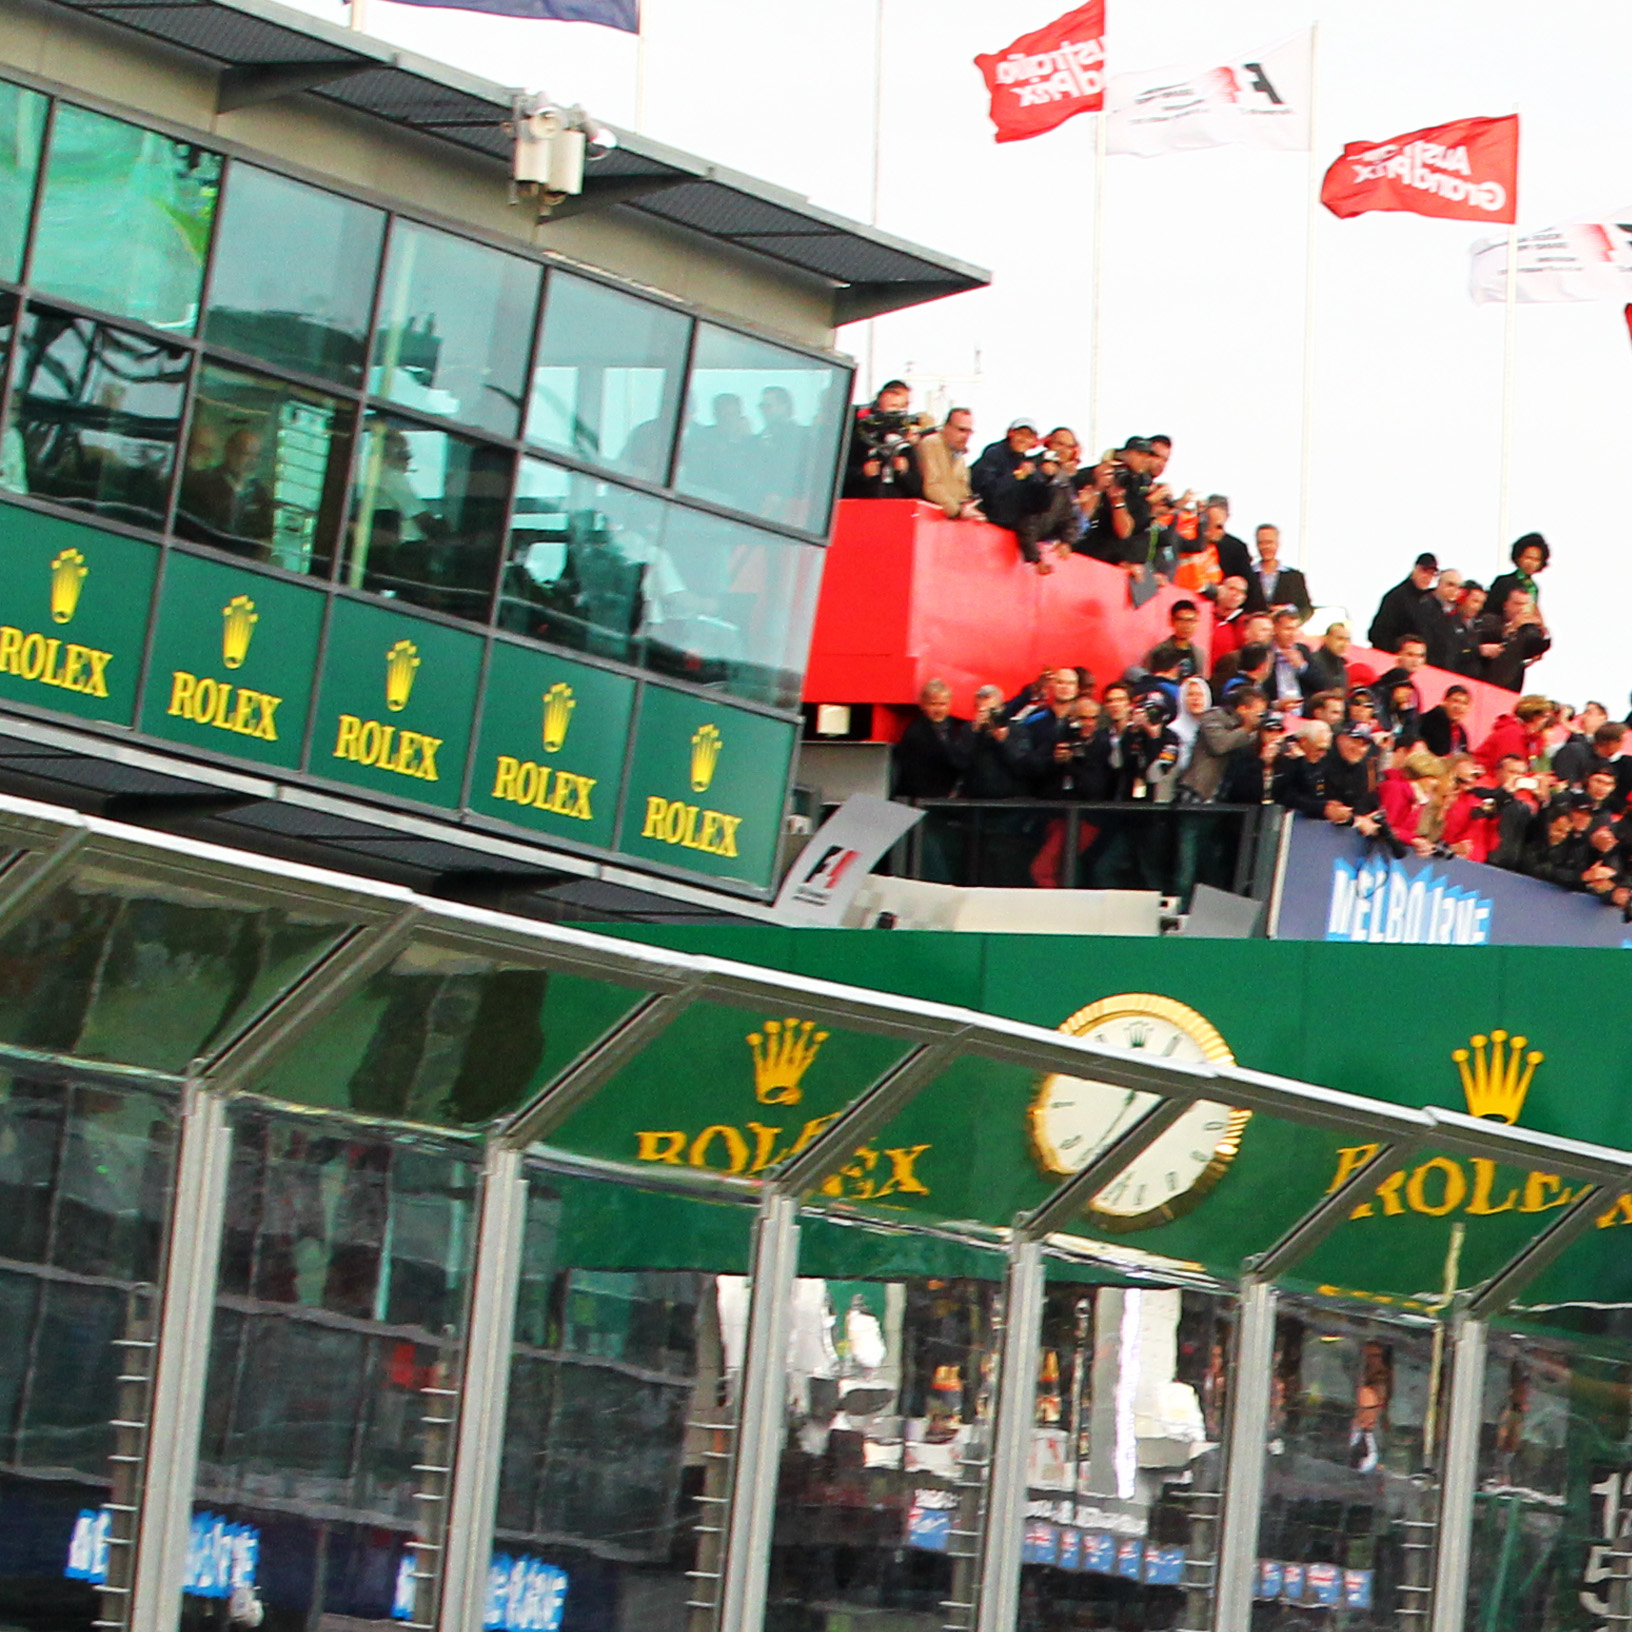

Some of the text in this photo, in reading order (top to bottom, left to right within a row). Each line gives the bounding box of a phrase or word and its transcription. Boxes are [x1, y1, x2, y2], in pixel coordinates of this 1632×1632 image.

[0, 625, 114, 698] ROLEX
[166, 671, 283, 741] ROLEX
[333, 714, 443, 781] ROLEX
[491, 755, 597, 820] ROLEX
[640, 796, 743, 858] ROLEX
[803, 844, 861, 889] F1
[1326, 867, 1491, 946] MELBOURNE
